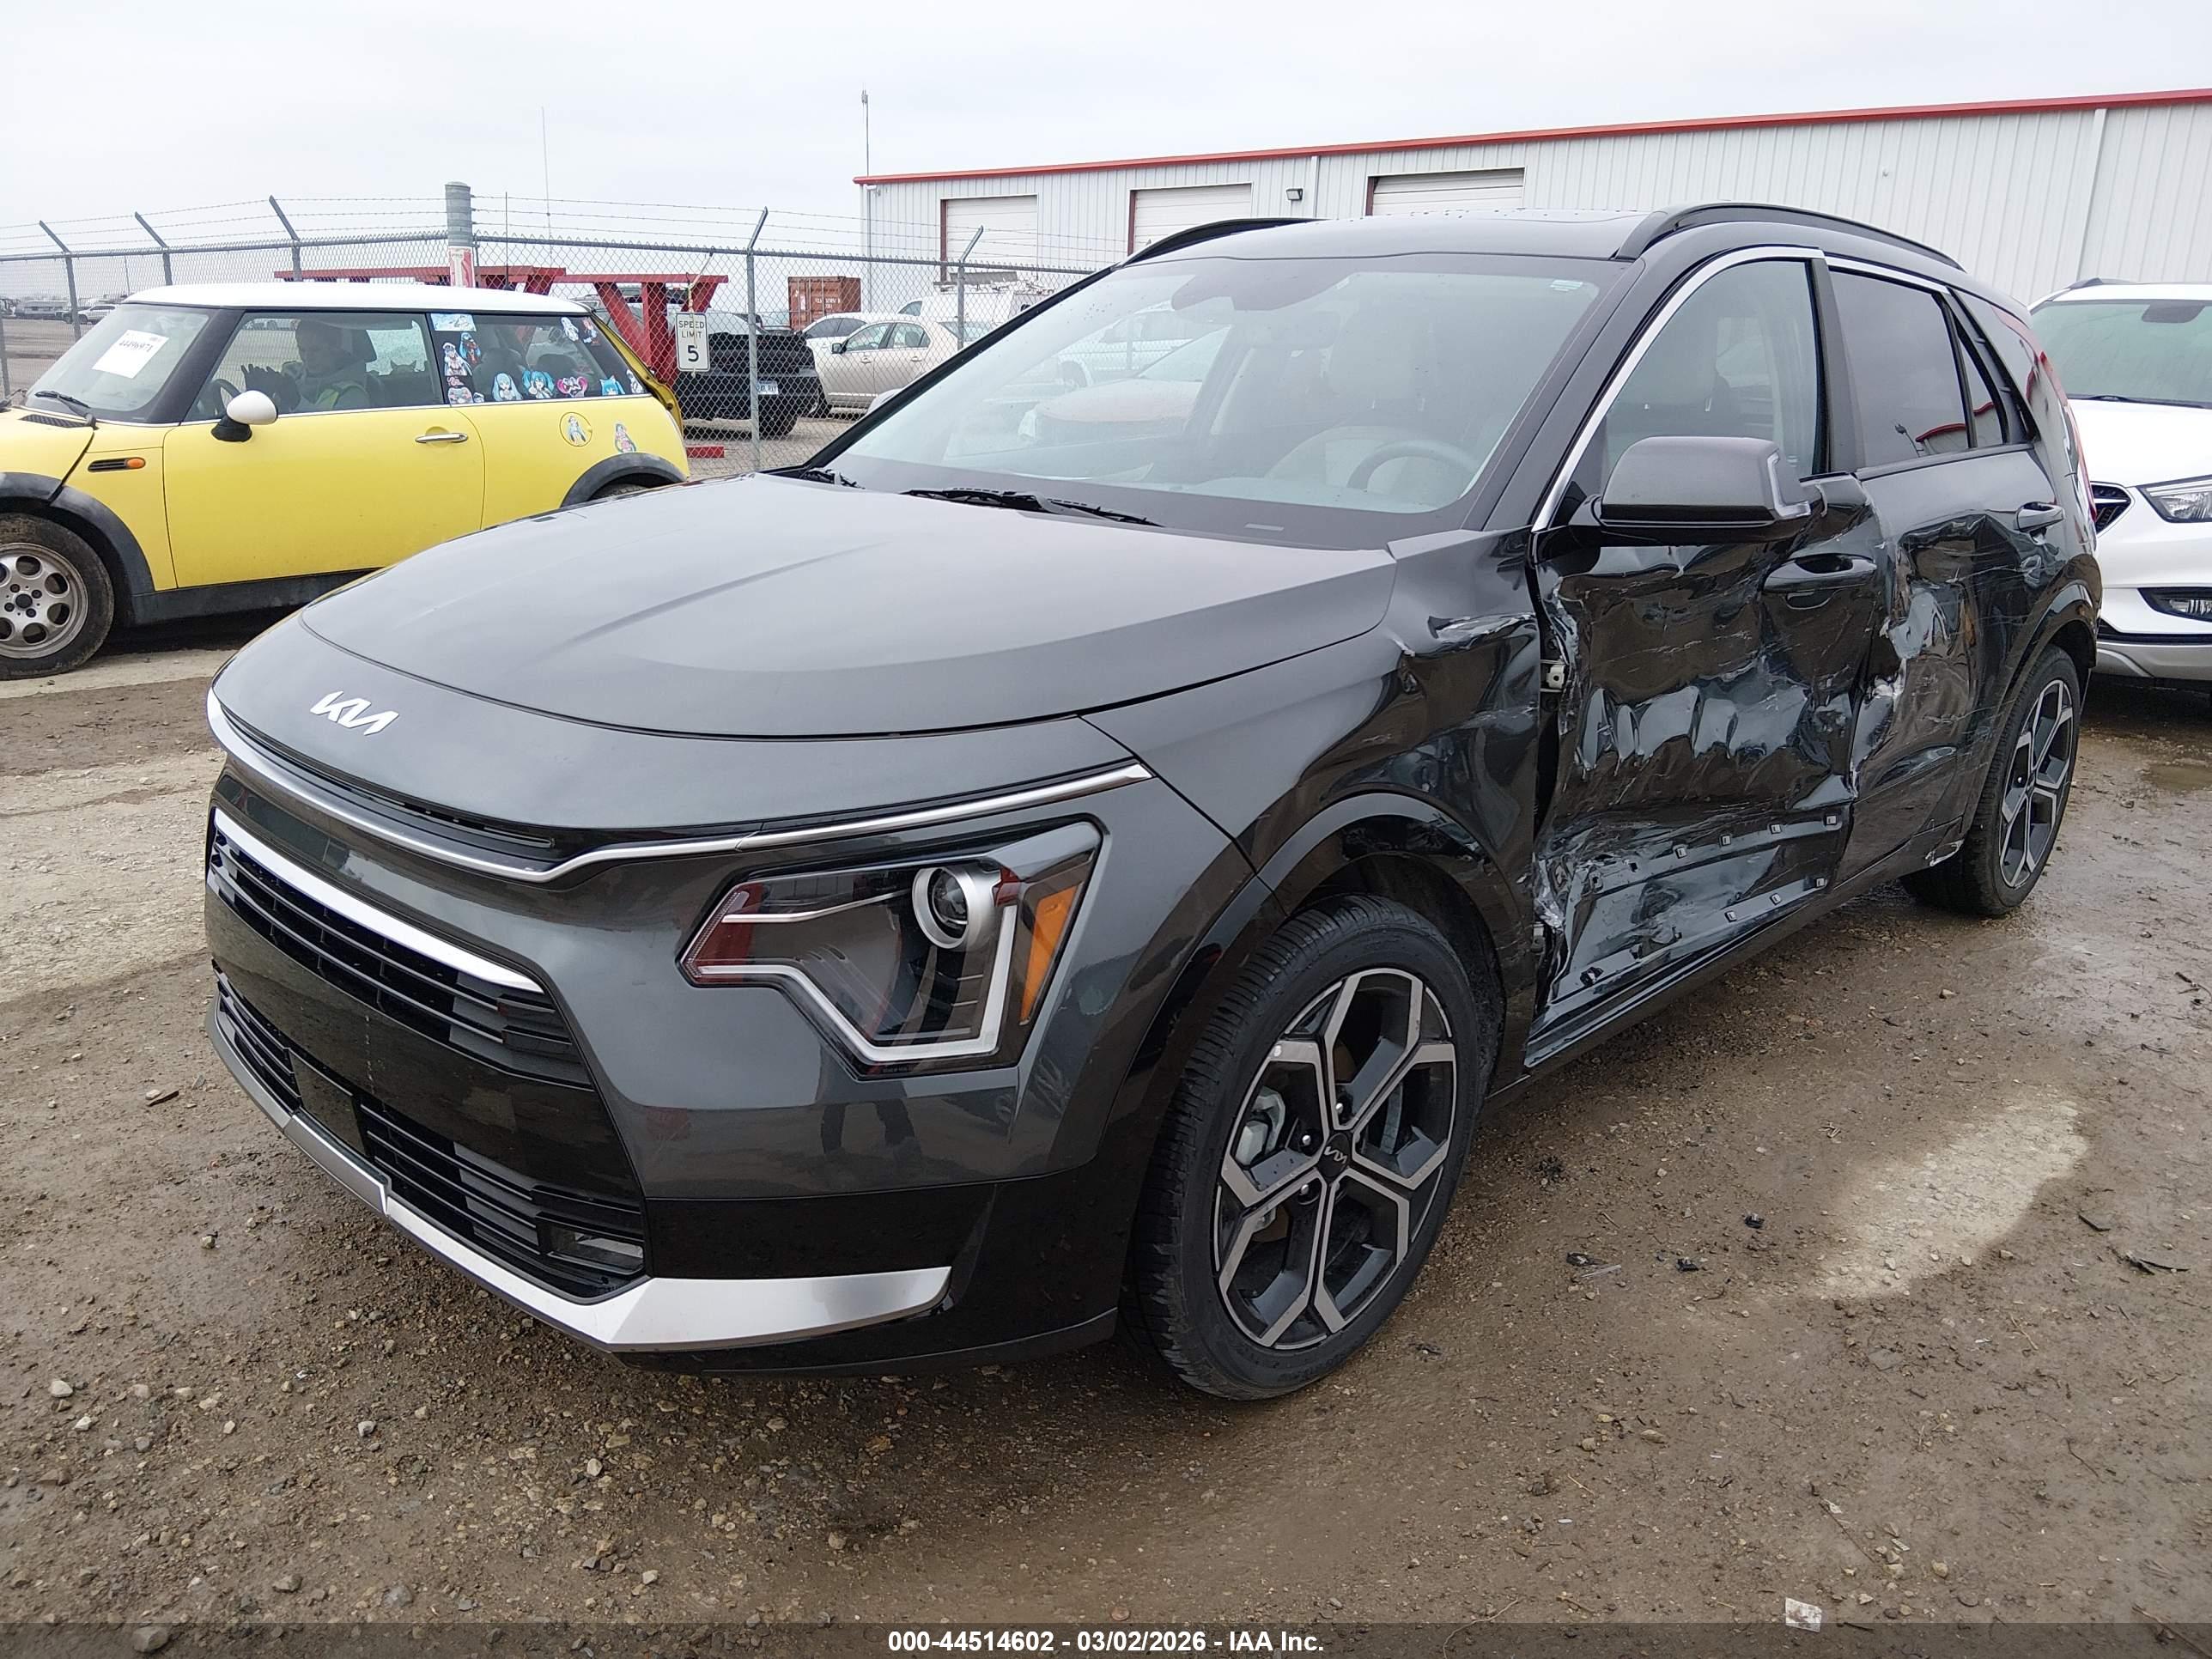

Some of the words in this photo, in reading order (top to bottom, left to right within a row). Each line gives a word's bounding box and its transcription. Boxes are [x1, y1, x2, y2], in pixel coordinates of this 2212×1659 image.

[678, 320, 705, 329] SPEED
[681, 331, 702, 339] LIMIT
[688, 345, 699, 362] 5
[310, 690, 399, 736] KIA
